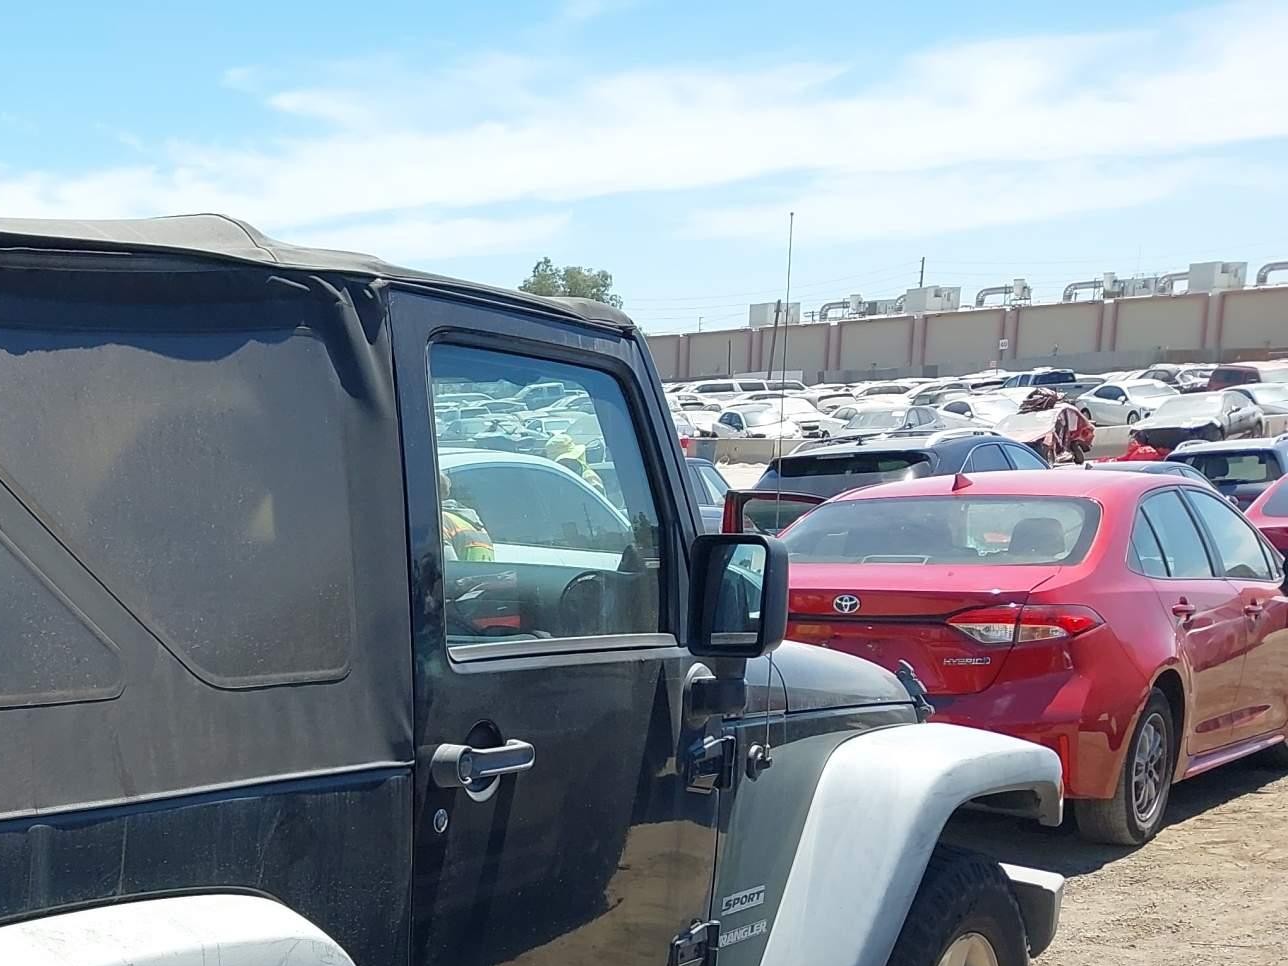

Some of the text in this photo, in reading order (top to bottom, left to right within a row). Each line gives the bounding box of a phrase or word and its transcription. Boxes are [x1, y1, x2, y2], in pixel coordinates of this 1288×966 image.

[943, 656, 991, 666] HYBRID
[723, 891, 765, 912] SPORT
[719, 919, 768, 948] RANGLER
